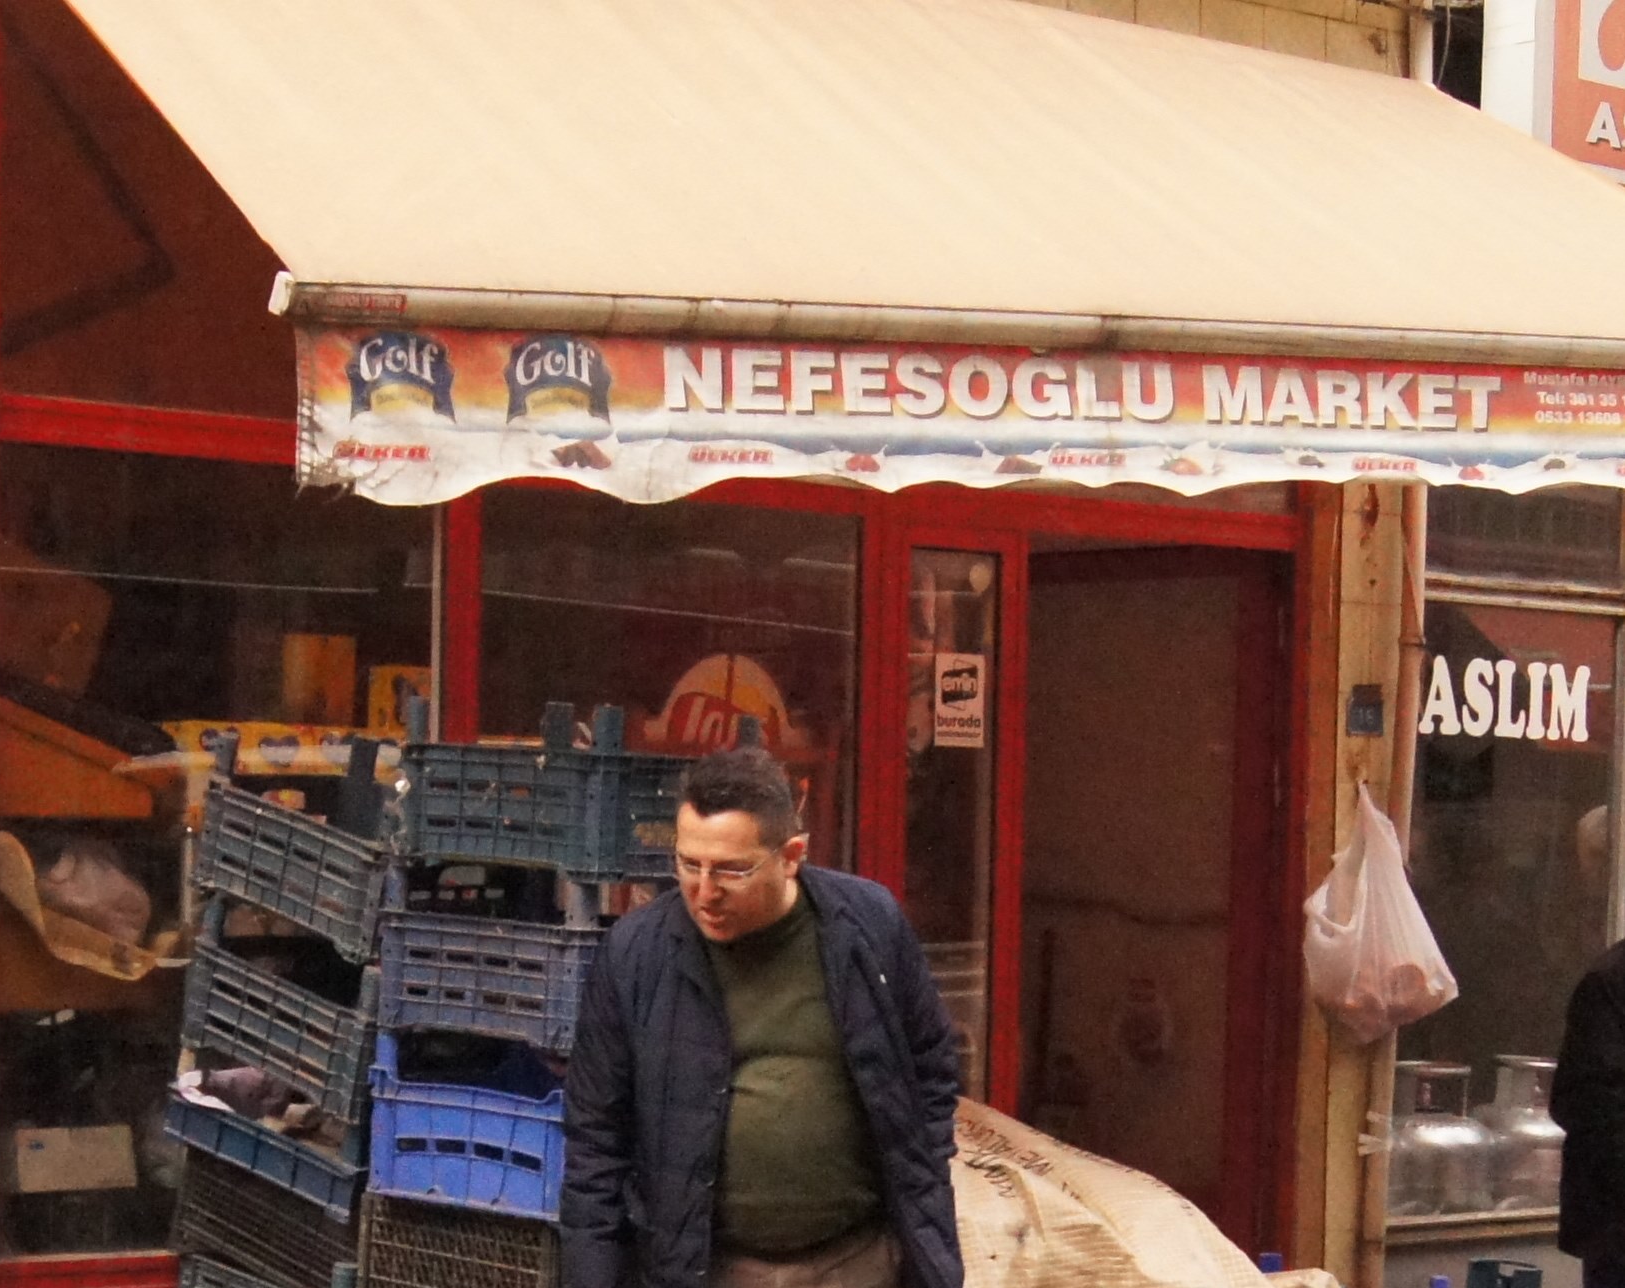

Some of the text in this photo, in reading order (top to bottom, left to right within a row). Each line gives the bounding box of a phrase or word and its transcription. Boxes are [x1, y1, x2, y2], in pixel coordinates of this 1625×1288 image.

[360, 338, 438, 384] Golf
[515, 341, 594, 387] Golf
[1523, 370, 1584, 386] Mustafa
[1201, 364, 1502, 433] MARKET
[936, 714, 982, 729] burada
[1418, 655, 1591, 743] ASLIM
